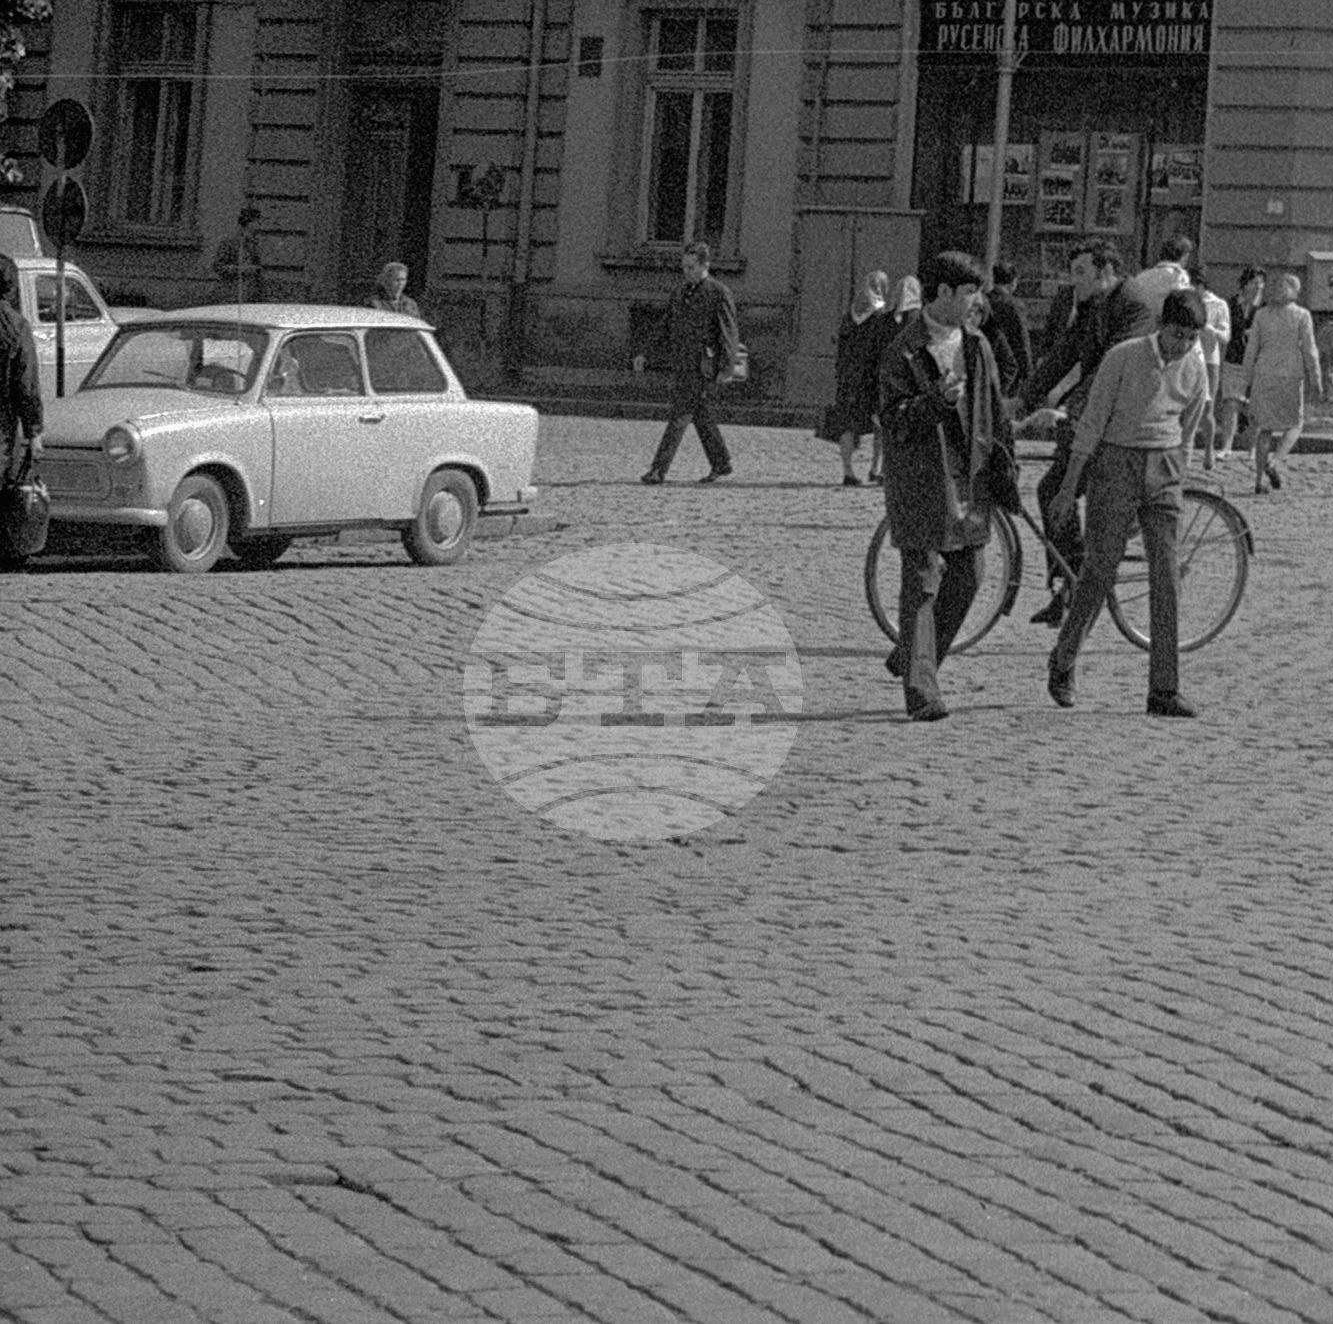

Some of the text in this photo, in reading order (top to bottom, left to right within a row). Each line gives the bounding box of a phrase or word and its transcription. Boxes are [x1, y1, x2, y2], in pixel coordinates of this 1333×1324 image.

[1109, 1, 1210, 20] МУЗИКА
[936, 21, 1205, 54] РУСЕНСА ФИЛХАРМОНИЯ
